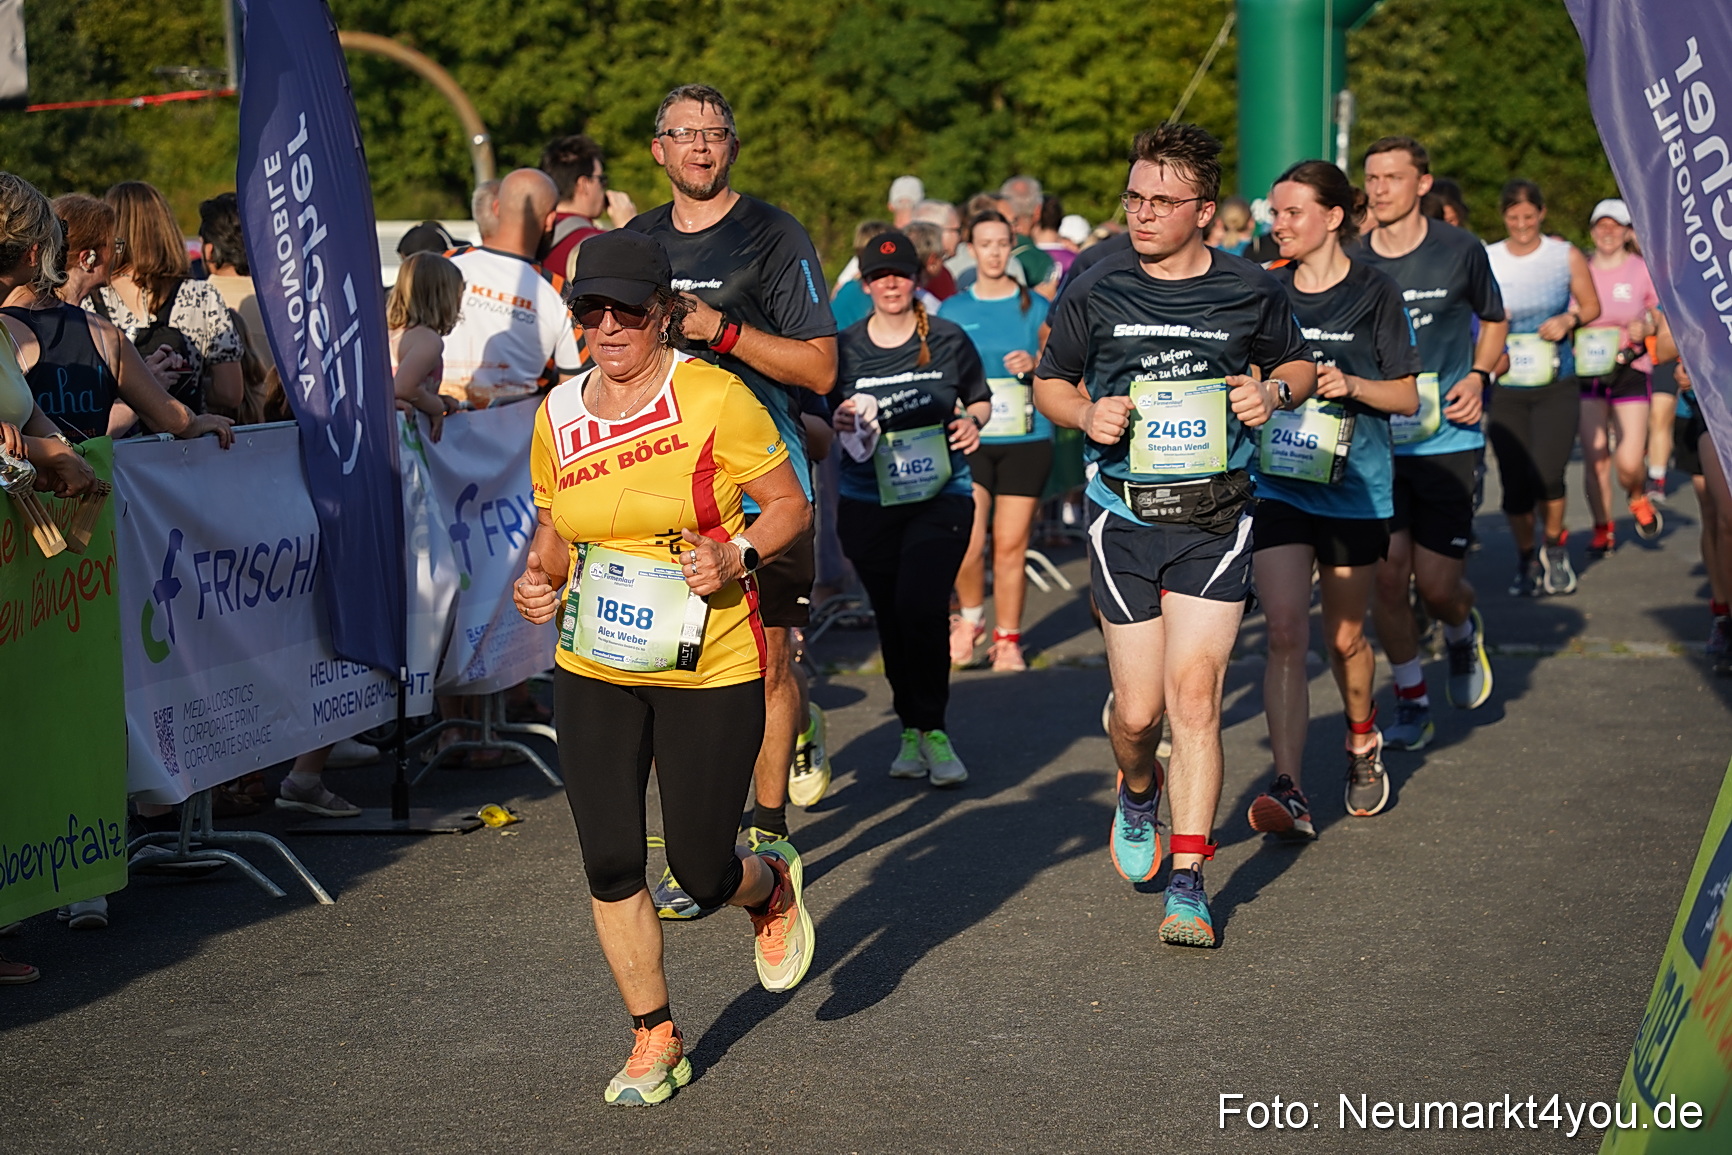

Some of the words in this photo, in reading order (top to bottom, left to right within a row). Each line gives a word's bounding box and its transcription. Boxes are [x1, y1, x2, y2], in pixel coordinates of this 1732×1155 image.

[1113, 324, 1190, 337] Schmidt
[1140, 355, 1159, 368] Wir
[1160, 348, 1194, 364] liefern
[1135, 371, 1157, 382] auch
[1158, 368, 1171, 379] zu
[1192, 360, 1208, 373] ab!
[1146, 419, 1207, 439] 2463
[1271, 428, 1319, 450] 2456
[1147, 443, 1182, 453] Stephan
[1184, 442, 1210, 451] Wendl
[558, 458, 611, 492] MAX
[617, 433, 690, 470] BÖGL
[888, 457, 935, 478] 2462
[597, 595, 654, 631] 1858
[597, 625, 615, 639] Alex
[617, 631, 648, 646] Weber
[310, 657, 349, 688] HEUTE
[313, 688, 363, 726] MORGEN
[183, 712, 235, 744] CORPORATE
[235, 704, 260, 728] PRINT
[184, 736, 236, 769] CORPORATE
[237, 724, 272, 753] SIGNAGE
